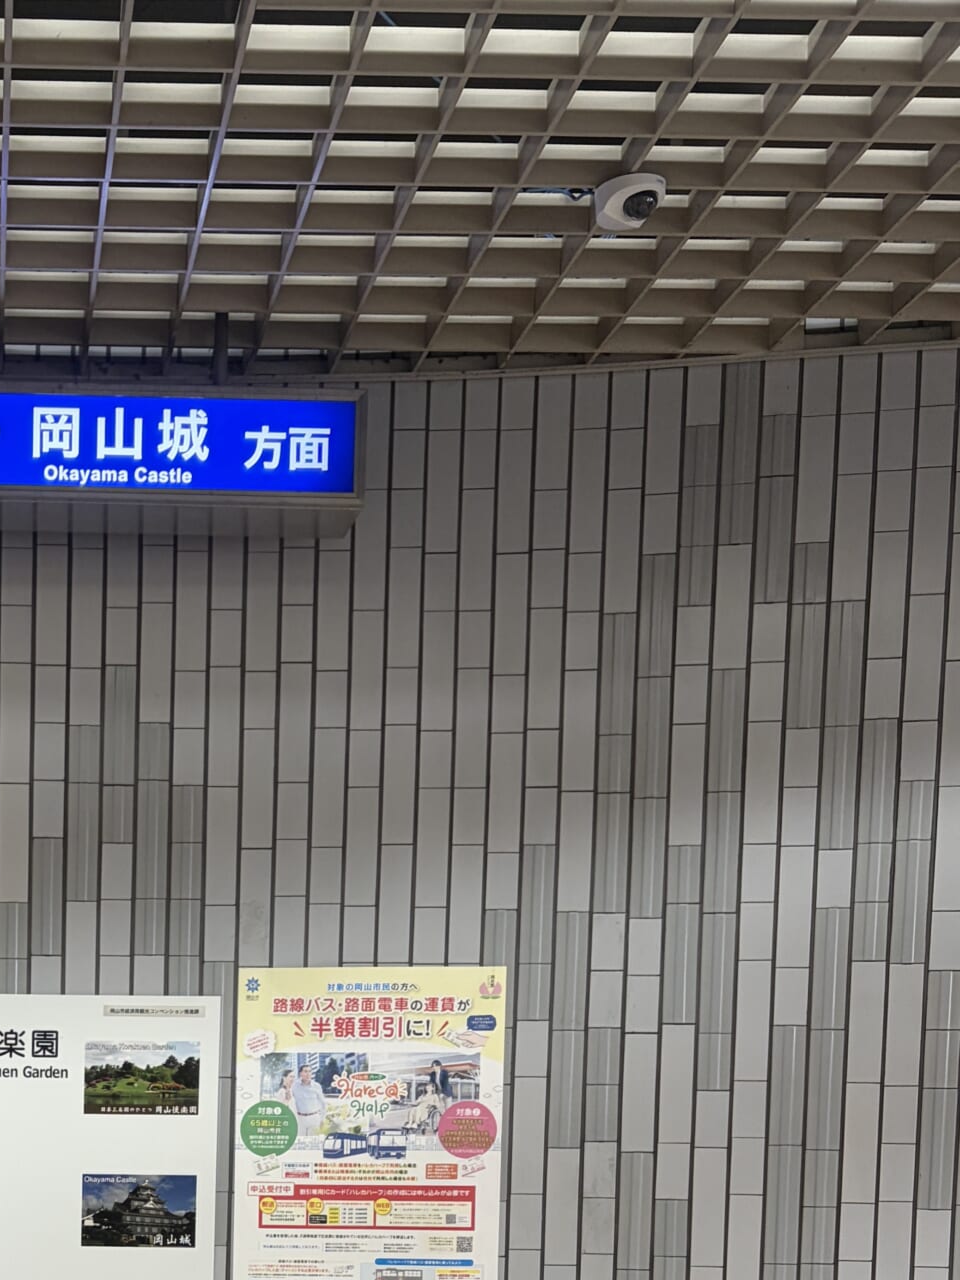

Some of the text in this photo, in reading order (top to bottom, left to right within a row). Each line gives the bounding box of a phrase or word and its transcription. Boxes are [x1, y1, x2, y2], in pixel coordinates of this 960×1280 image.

[243, 425, 332, 472] 方面
[43, 465, 129, 486] Okayama
[134, 466, 193, 484] Castle
[272, 997, 471, 1013] 路線バス・路面電車の運賃が
[23, 1066, 68, 1078] Garden
[84, 1176, 115, 1184] Okayama
[153, 1233, 192, 1246] 岡山城
